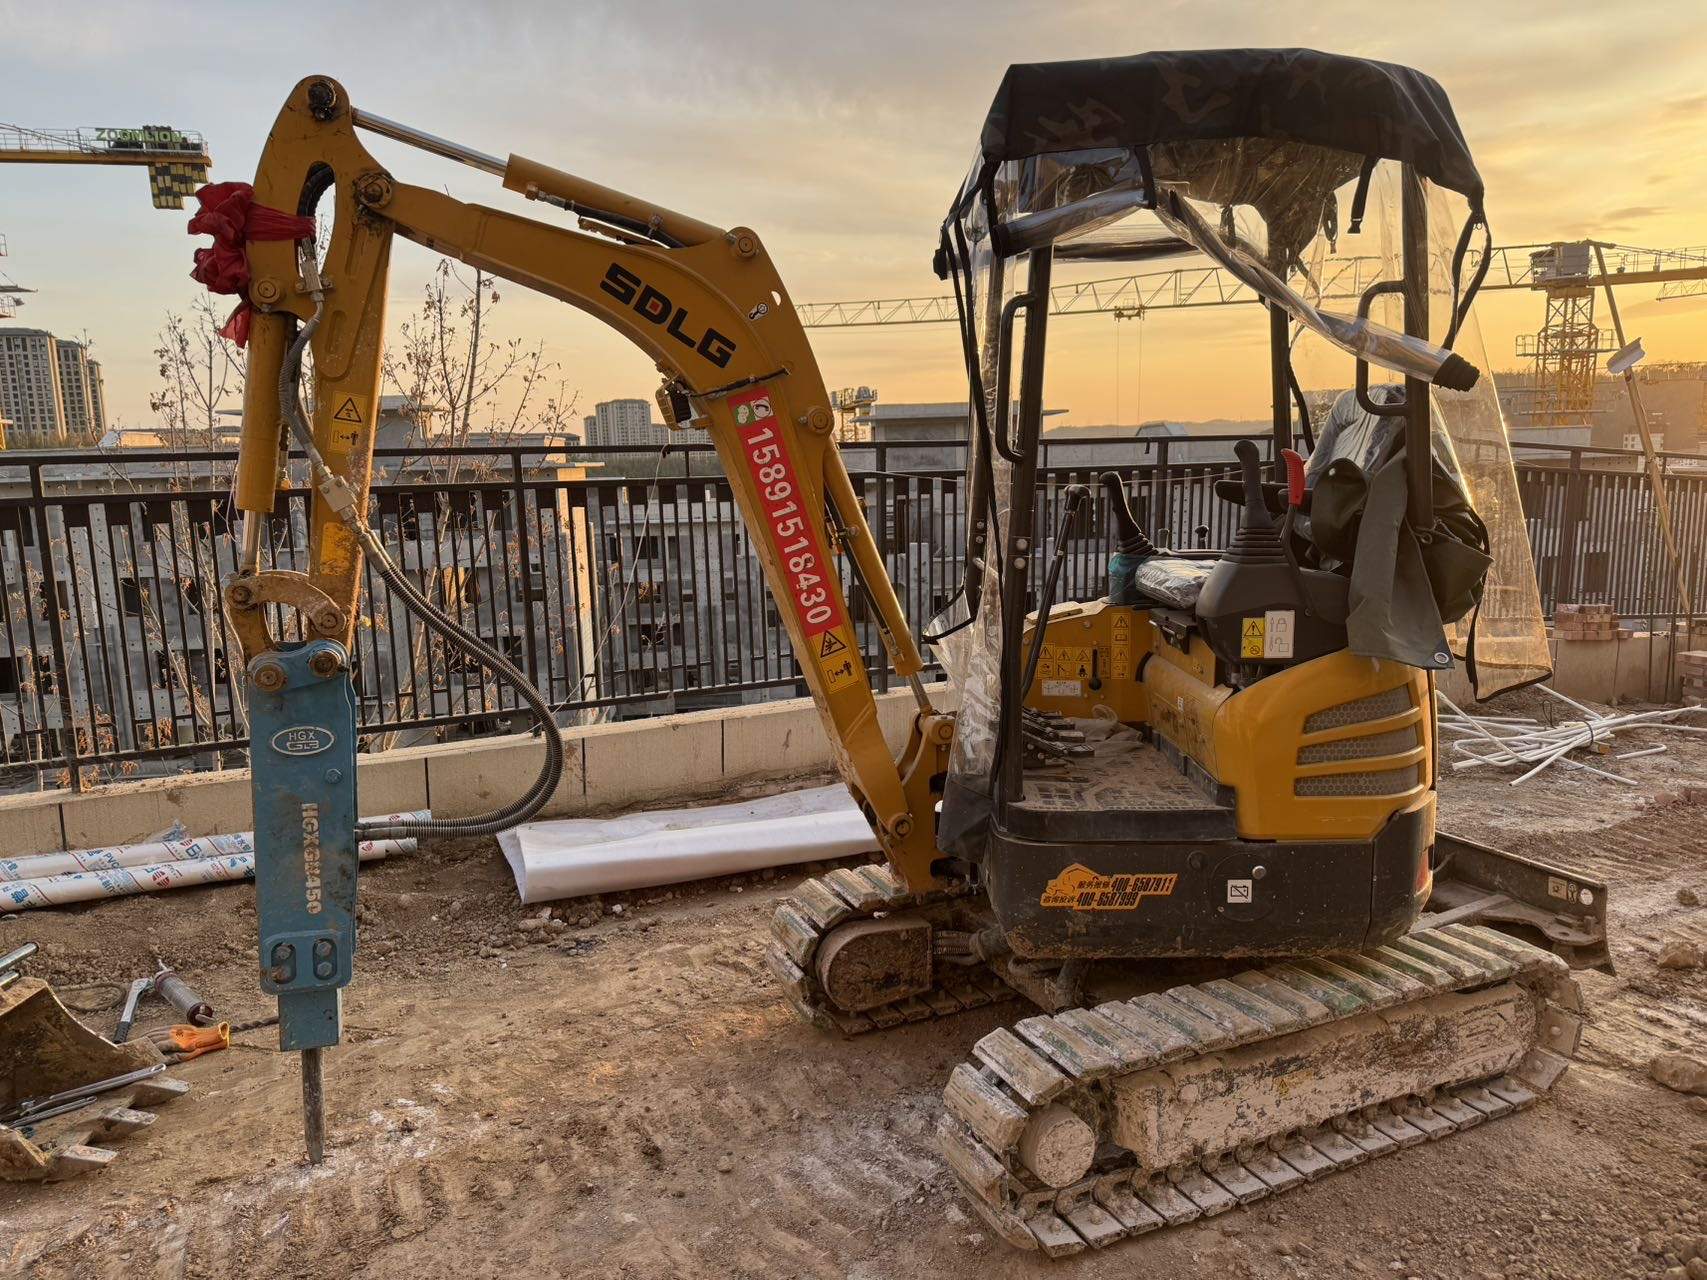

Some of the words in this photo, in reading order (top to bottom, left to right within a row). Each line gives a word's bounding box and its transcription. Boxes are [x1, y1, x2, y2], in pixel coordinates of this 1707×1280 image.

[95, 128, 182, 142] ZOOMLION
[600, 262, 736, 369] SDLG
[747, 427, 832, 625] 15891518430
[288, 731, 315, 741] HGX
